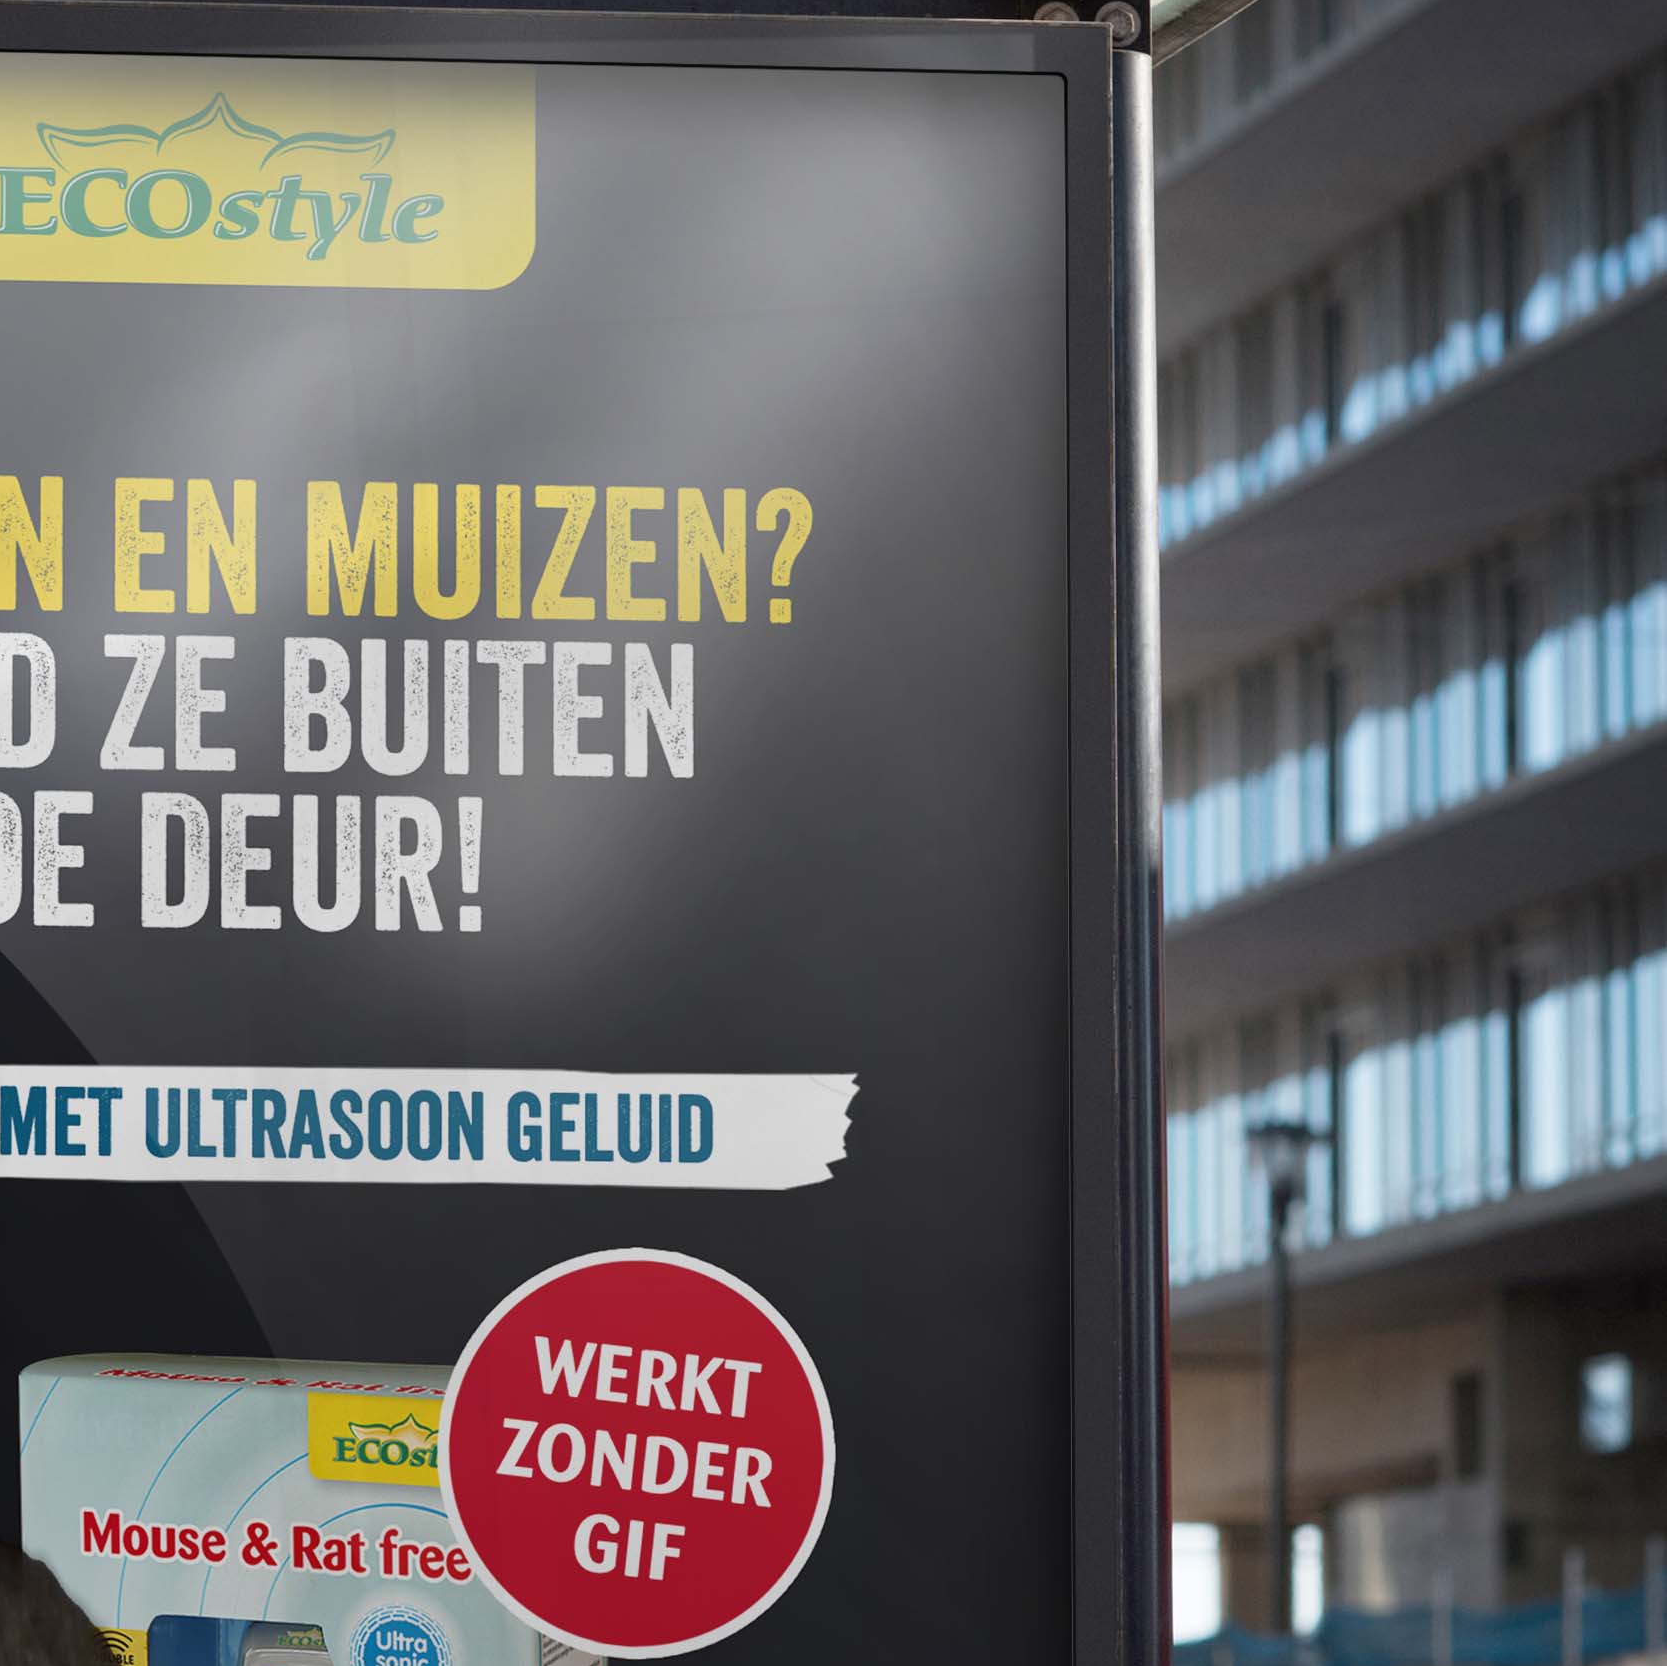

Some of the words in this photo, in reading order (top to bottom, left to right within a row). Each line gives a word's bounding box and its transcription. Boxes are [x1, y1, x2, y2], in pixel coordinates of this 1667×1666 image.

[115, 476, 257, 613] EN
[307, 482, 813, 624] MUIZEN?
[100, 633, 236, 772] ZE
[283, 636, 695, 779] BUITEN
[141, 791, 484, 933] DEUR!
[0, 1085, 123, 1157] MET
[145, 1087, 484, 1161] ULTRASOON
[507, 1091, 714, 1163] GELUID
[534, 1335, 763, 1419] WERKT
[333, 1436, 439, 1468] ECOst
[496, 1417, 773, 1508] ZONDER
[82, 1510, 226, 1563] Mouse
[241, 1522, 278, 1566] &
[292, 1525, 367, 1574] Rat
[379, 1528, 473, 1581] free
[573, 1513, 686, 1581] GIF
[375, 1630, 428, 1654] Ultra
